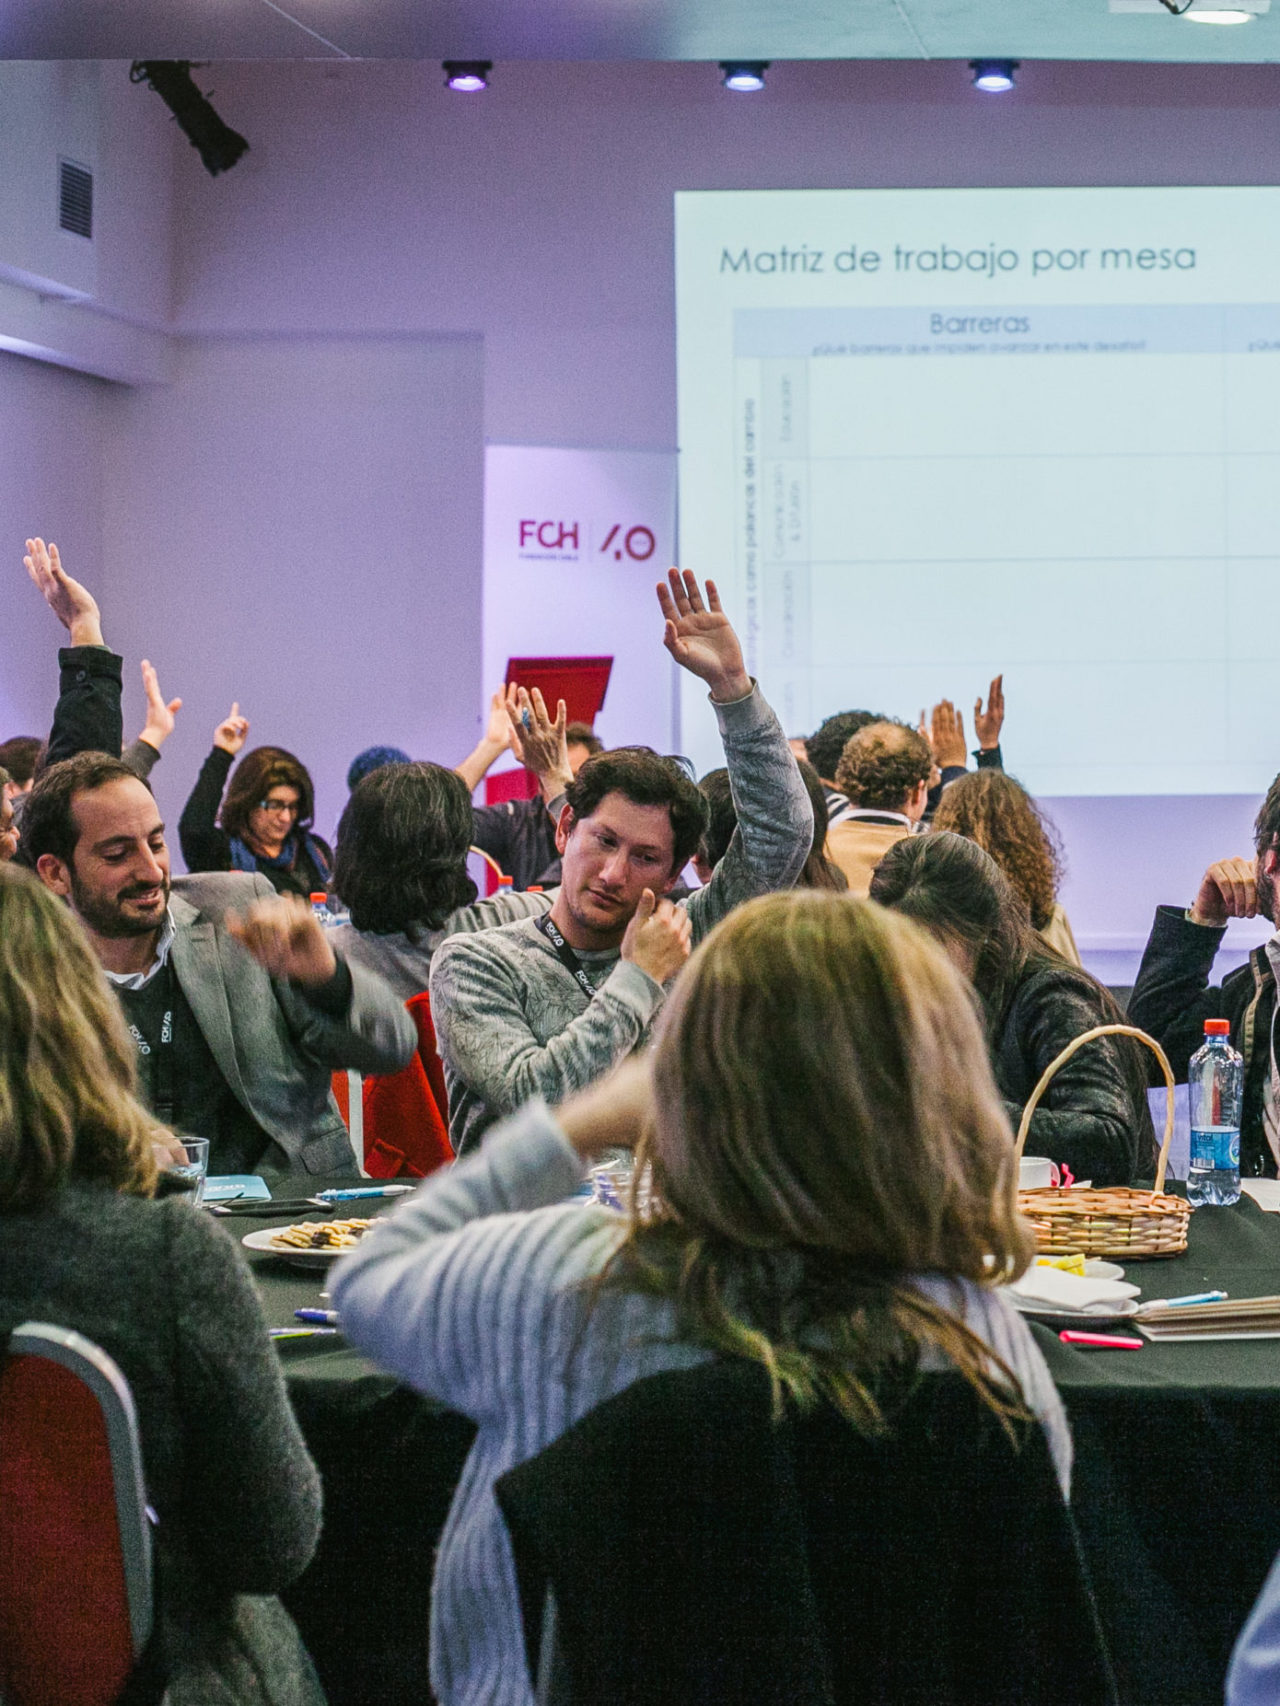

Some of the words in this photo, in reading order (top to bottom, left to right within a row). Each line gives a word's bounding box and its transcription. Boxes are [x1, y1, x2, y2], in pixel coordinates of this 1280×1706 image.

[720, 243, 823, 273] Matriz
[834, 243, 880, 273] de
[895, 242, 1019, 278] trabajo
[1032, 248, 1090, 277] por
[1101, 247, 1196, 270] mesa
[930, 312, 1031, 334] Barreras
[519, 520, 579, 550] FCH
[577, 969, 590, 985] FCH
[161, 1026, 170, 1043] FCH
